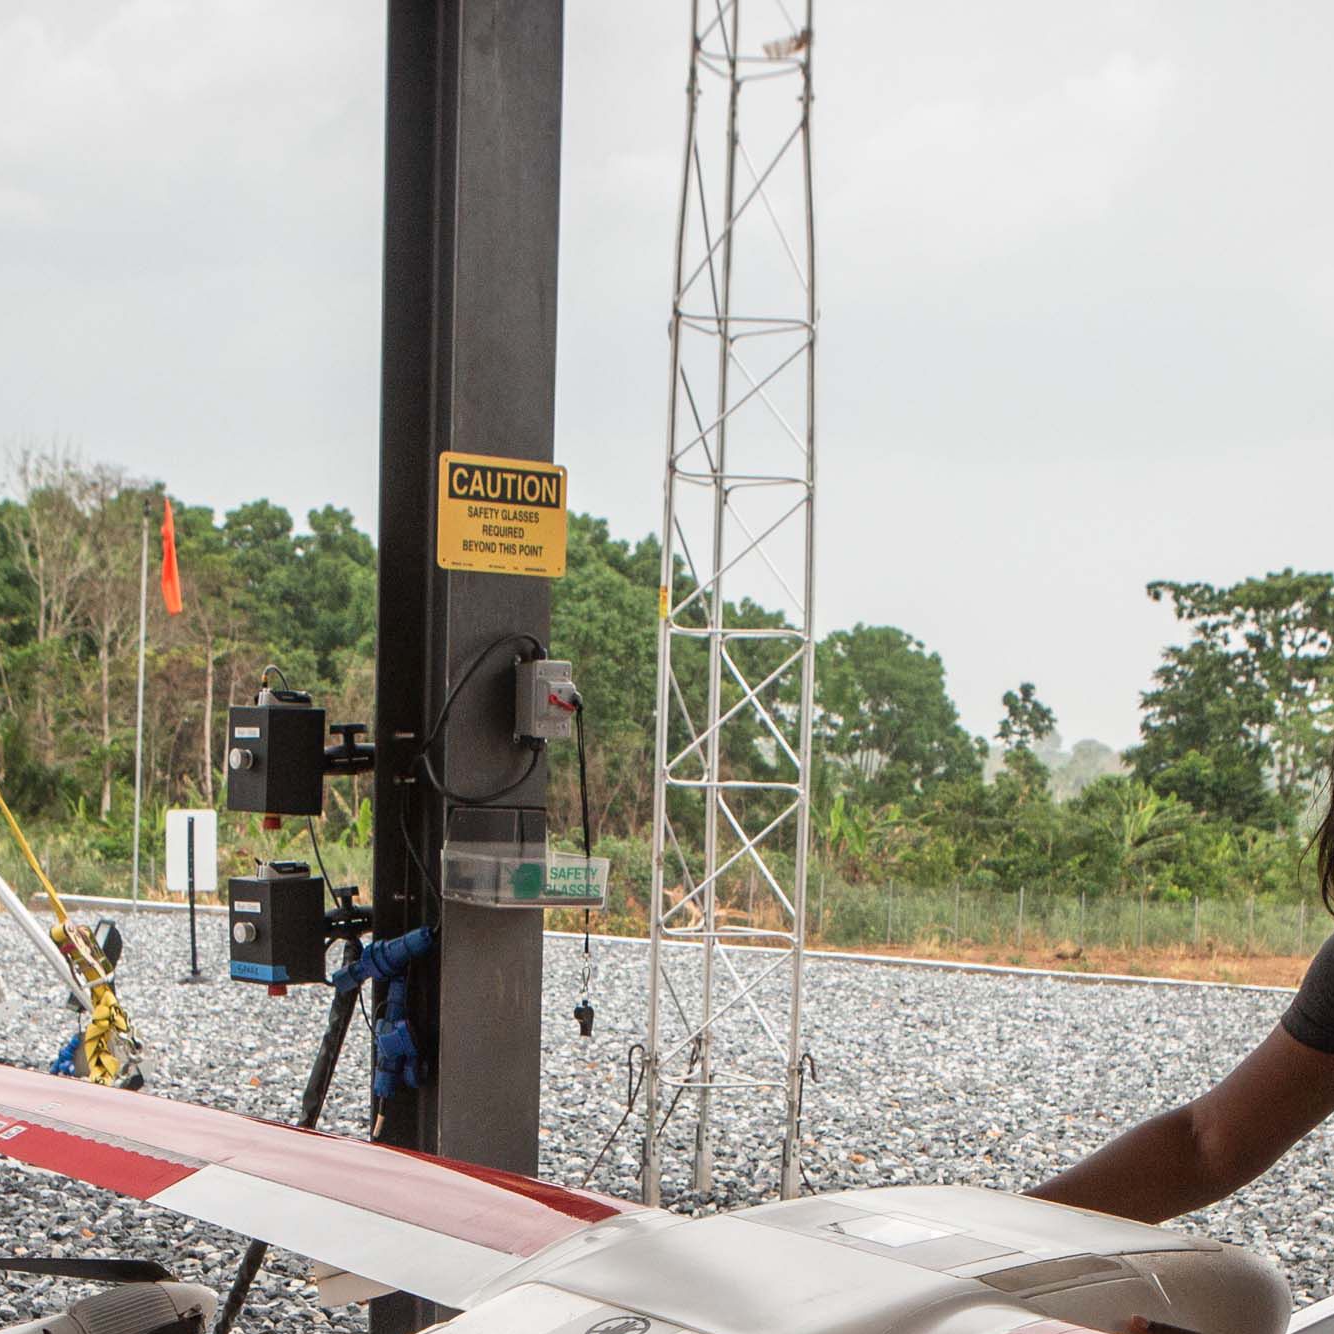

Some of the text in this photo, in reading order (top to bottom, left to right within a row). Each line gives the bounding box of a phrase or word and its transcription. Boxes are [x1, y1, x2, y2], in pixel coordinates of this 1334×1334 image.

[452, 467, 557, 503] CAUTION
[467, 506, 539, 523] SAFETY GLASSES
[482, 524, 524, 539] REQUIRED
[462, 539, 543, 557] BEYOND THIS POINT
[549, 866, 598, 880] SAFETY
